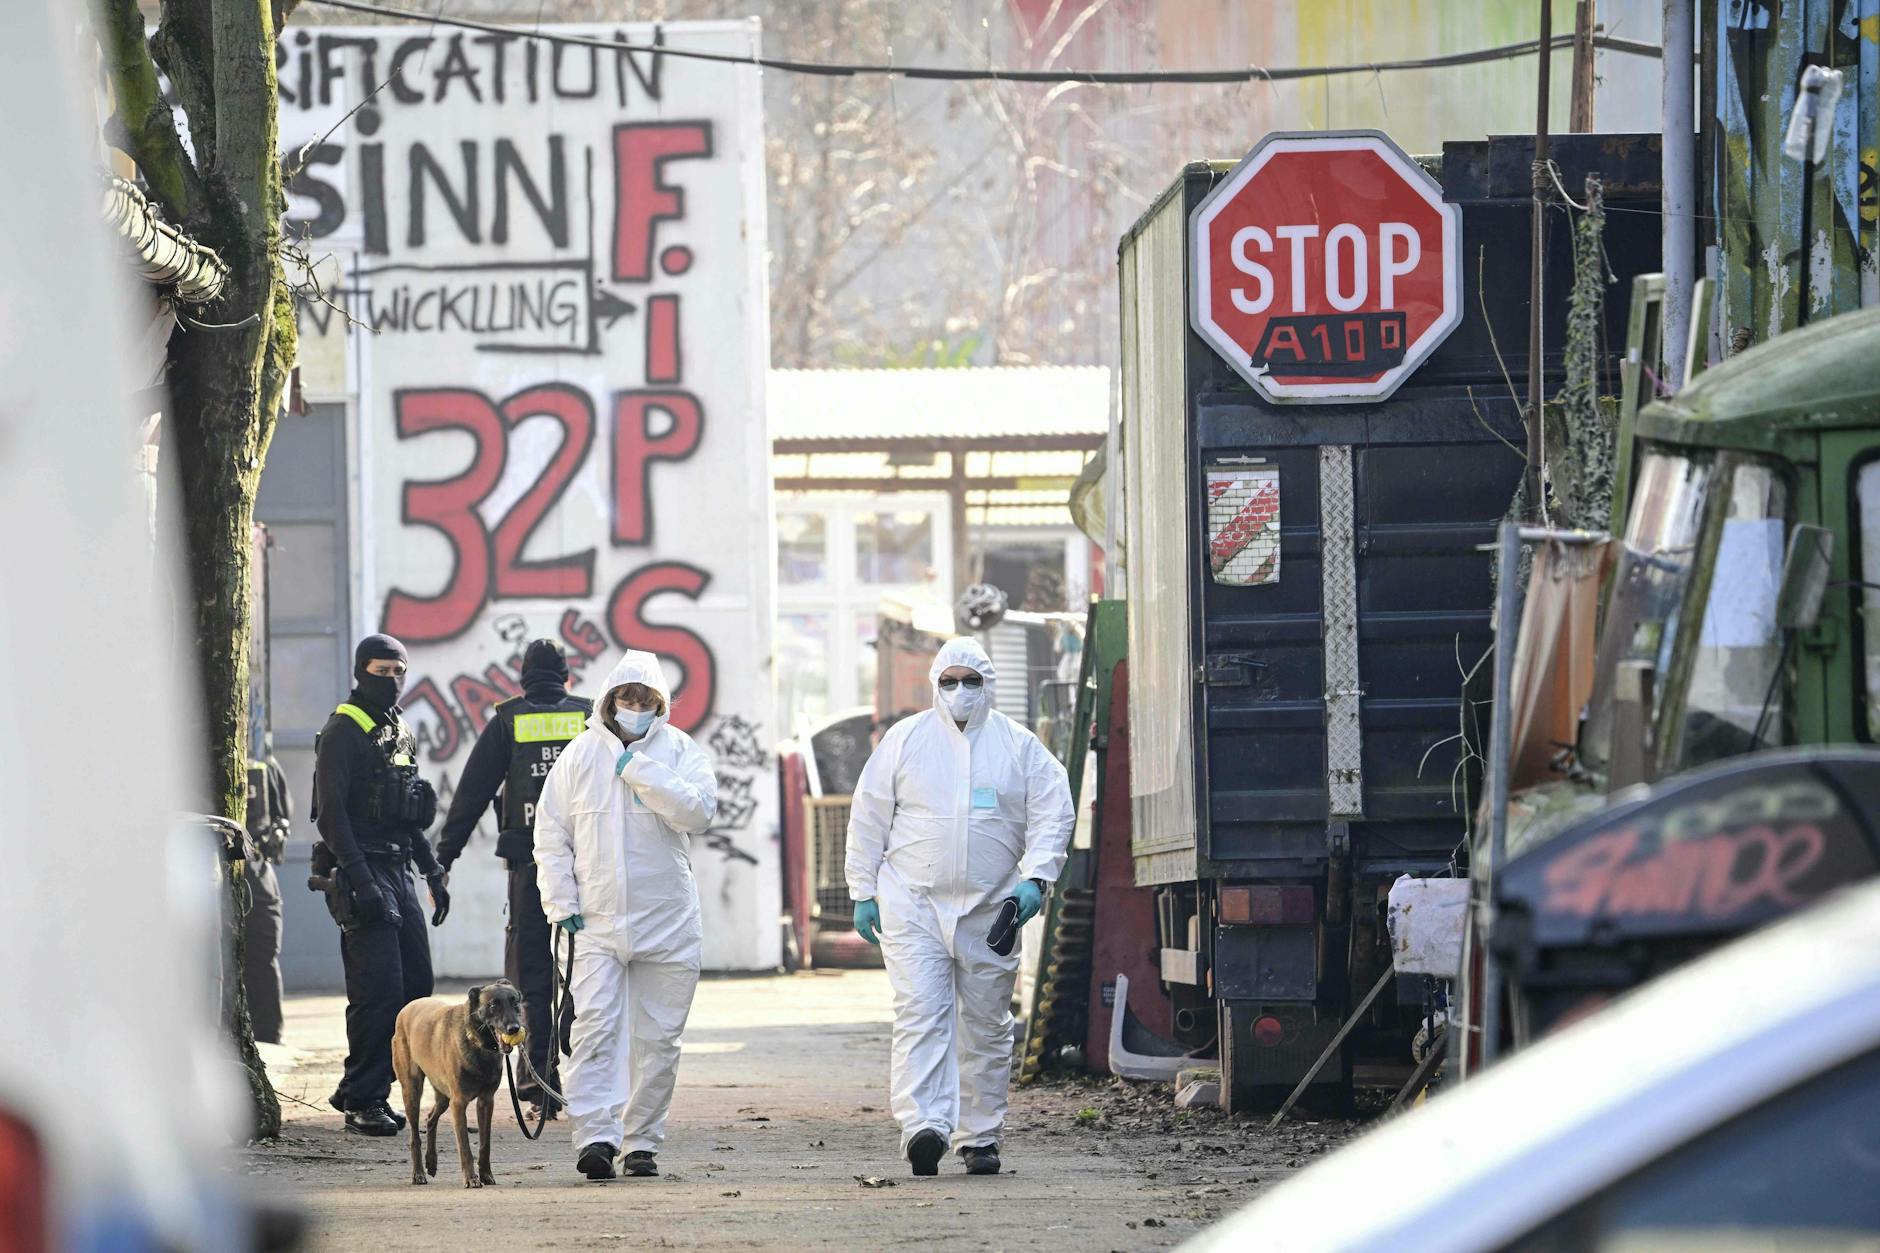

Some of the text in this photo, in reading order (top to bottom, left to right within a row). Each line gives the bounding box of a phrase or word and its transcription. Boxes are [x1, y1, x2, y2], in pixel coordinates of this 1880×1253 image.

[1230, 222, 1422, 315] STOP
[1263, 319, 1400, 361] A100
[378, 381, 597, 648] 32
[519, 716, 581, 738] POLIZEI
